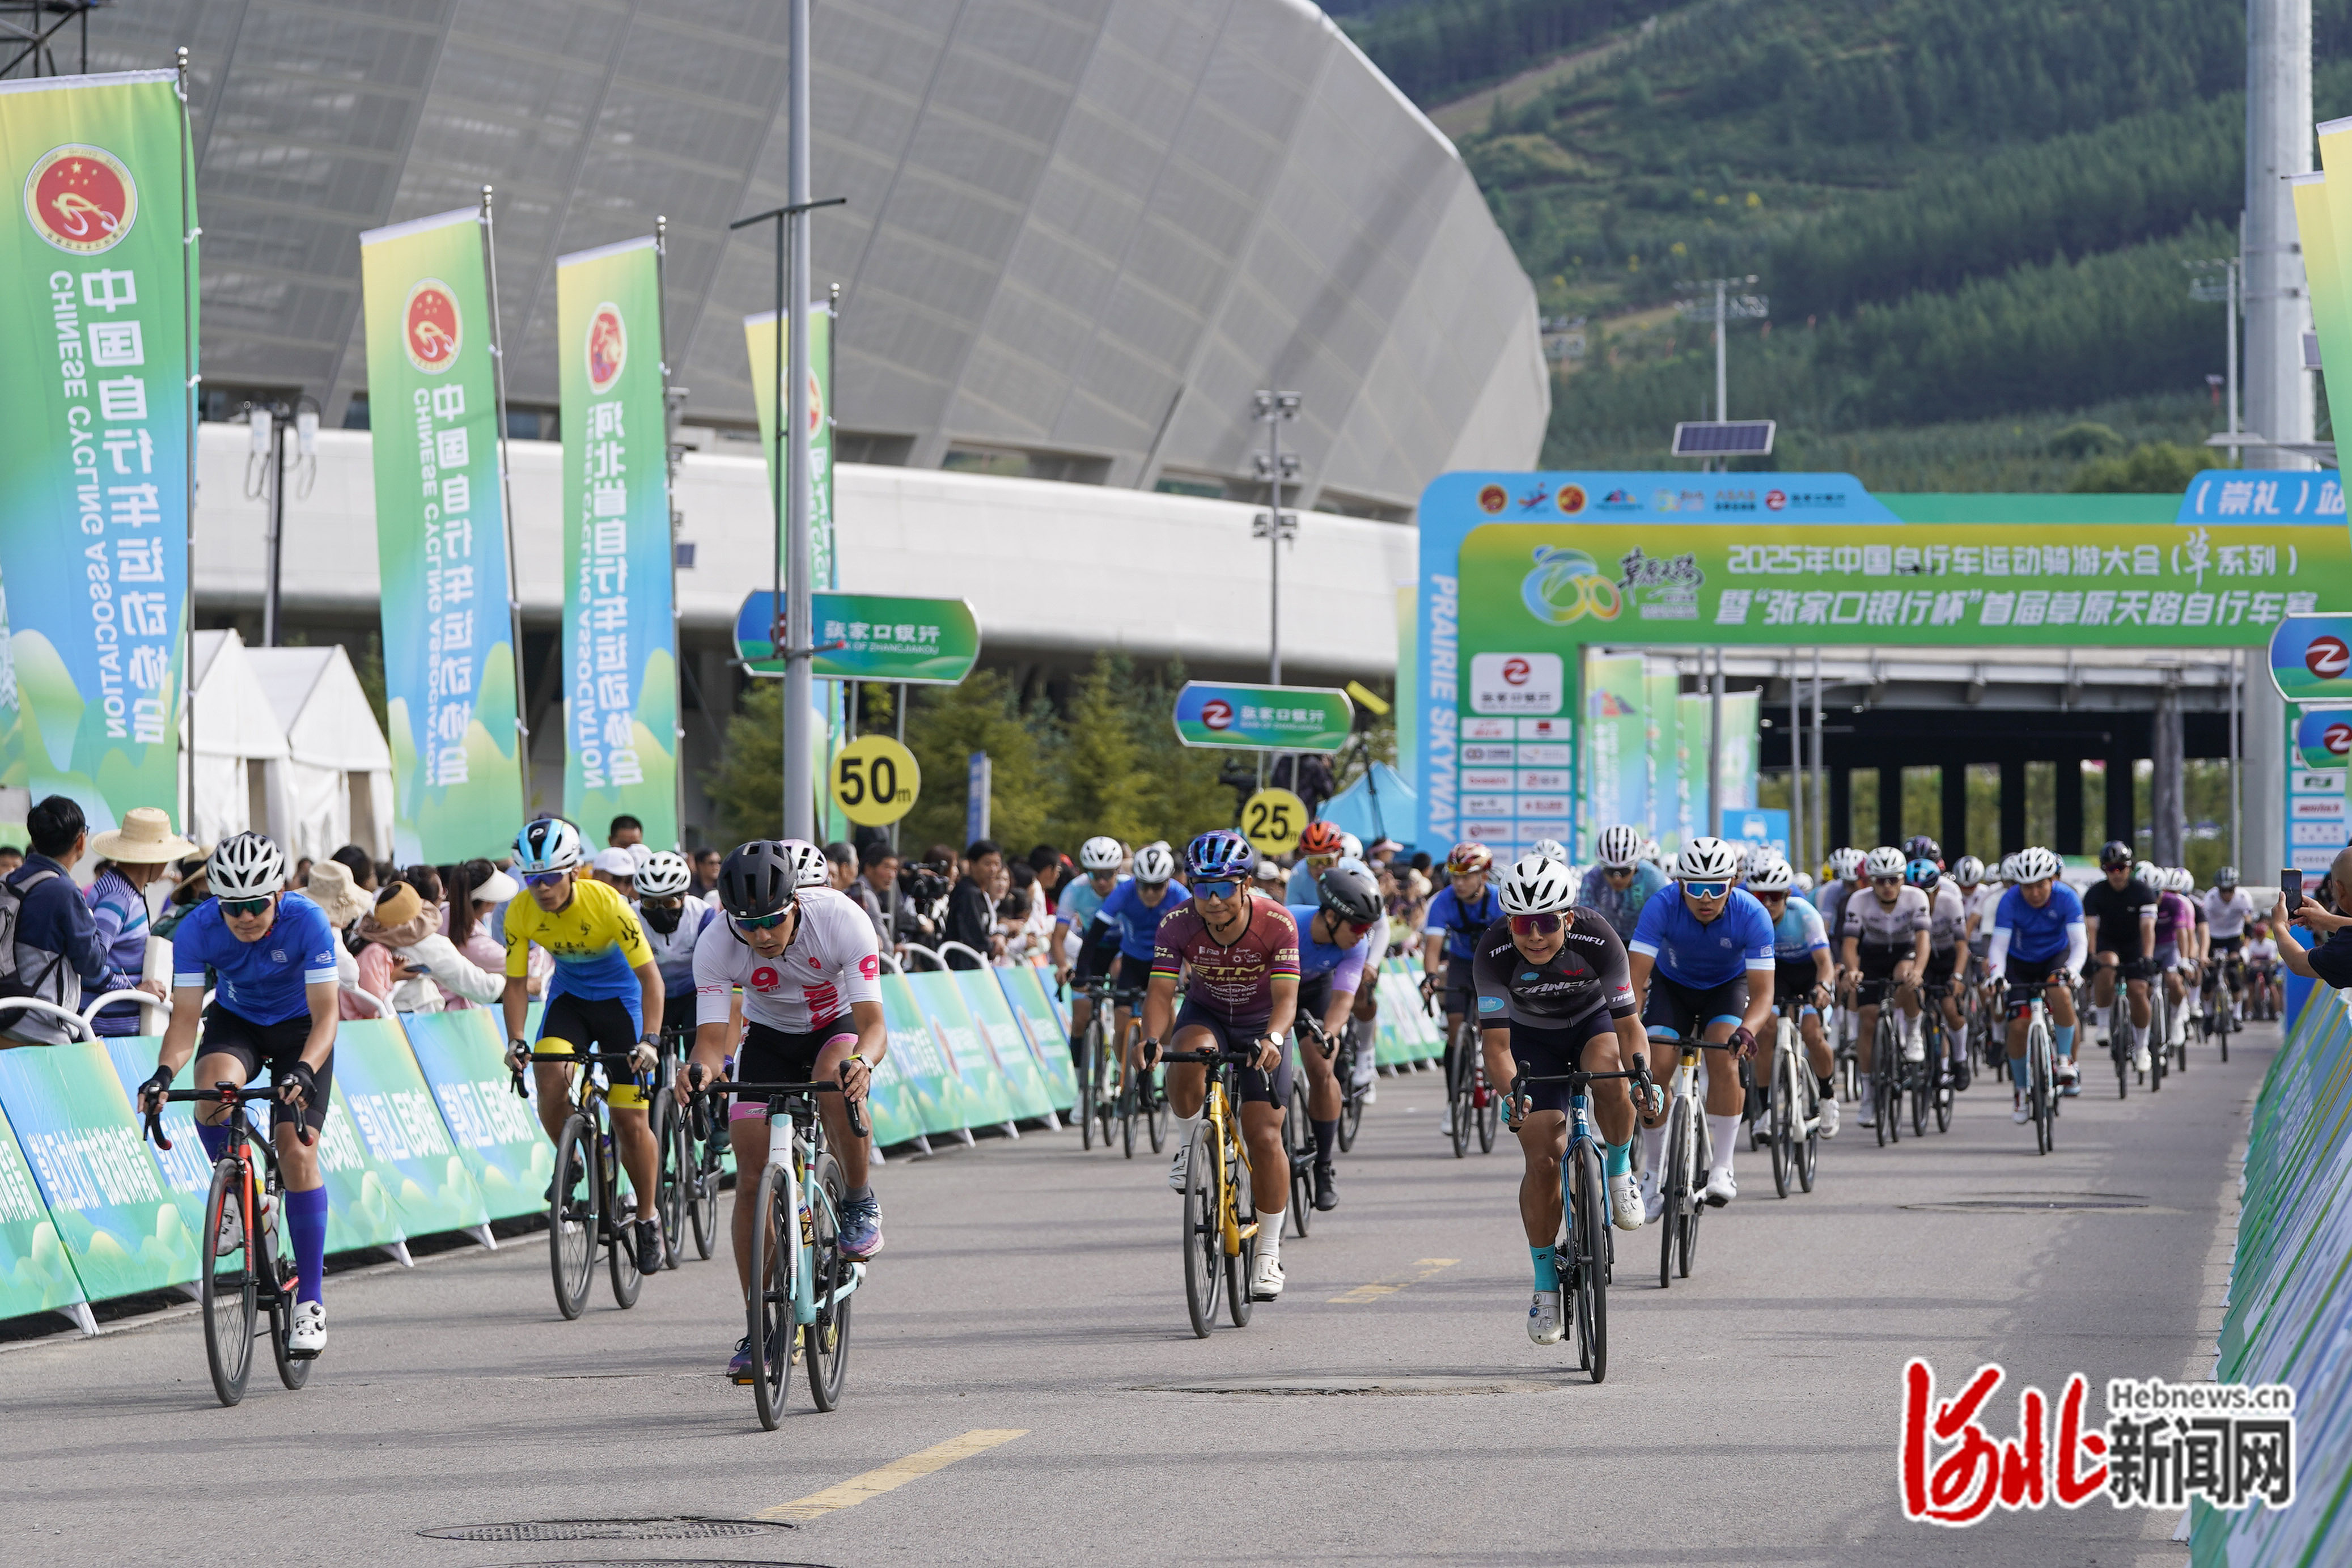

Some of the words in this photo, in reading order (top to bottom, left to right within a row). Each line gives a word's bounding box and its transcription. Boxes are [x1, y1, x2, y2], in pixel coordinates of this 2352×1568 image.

[1430, 574, 1458, 701] PRAIRIE
[1429, 706, 1458, 842] SKYWAY
[1160, 907, 1189, 928] ETM
[1567, 932, 1606, 946] TIANFU
[1190, 963, 1265, 975] ETM
[1512, 978, 1596, 993] TIANFU
[349, 1087, 449, 1163] 崇礼区人民政府
